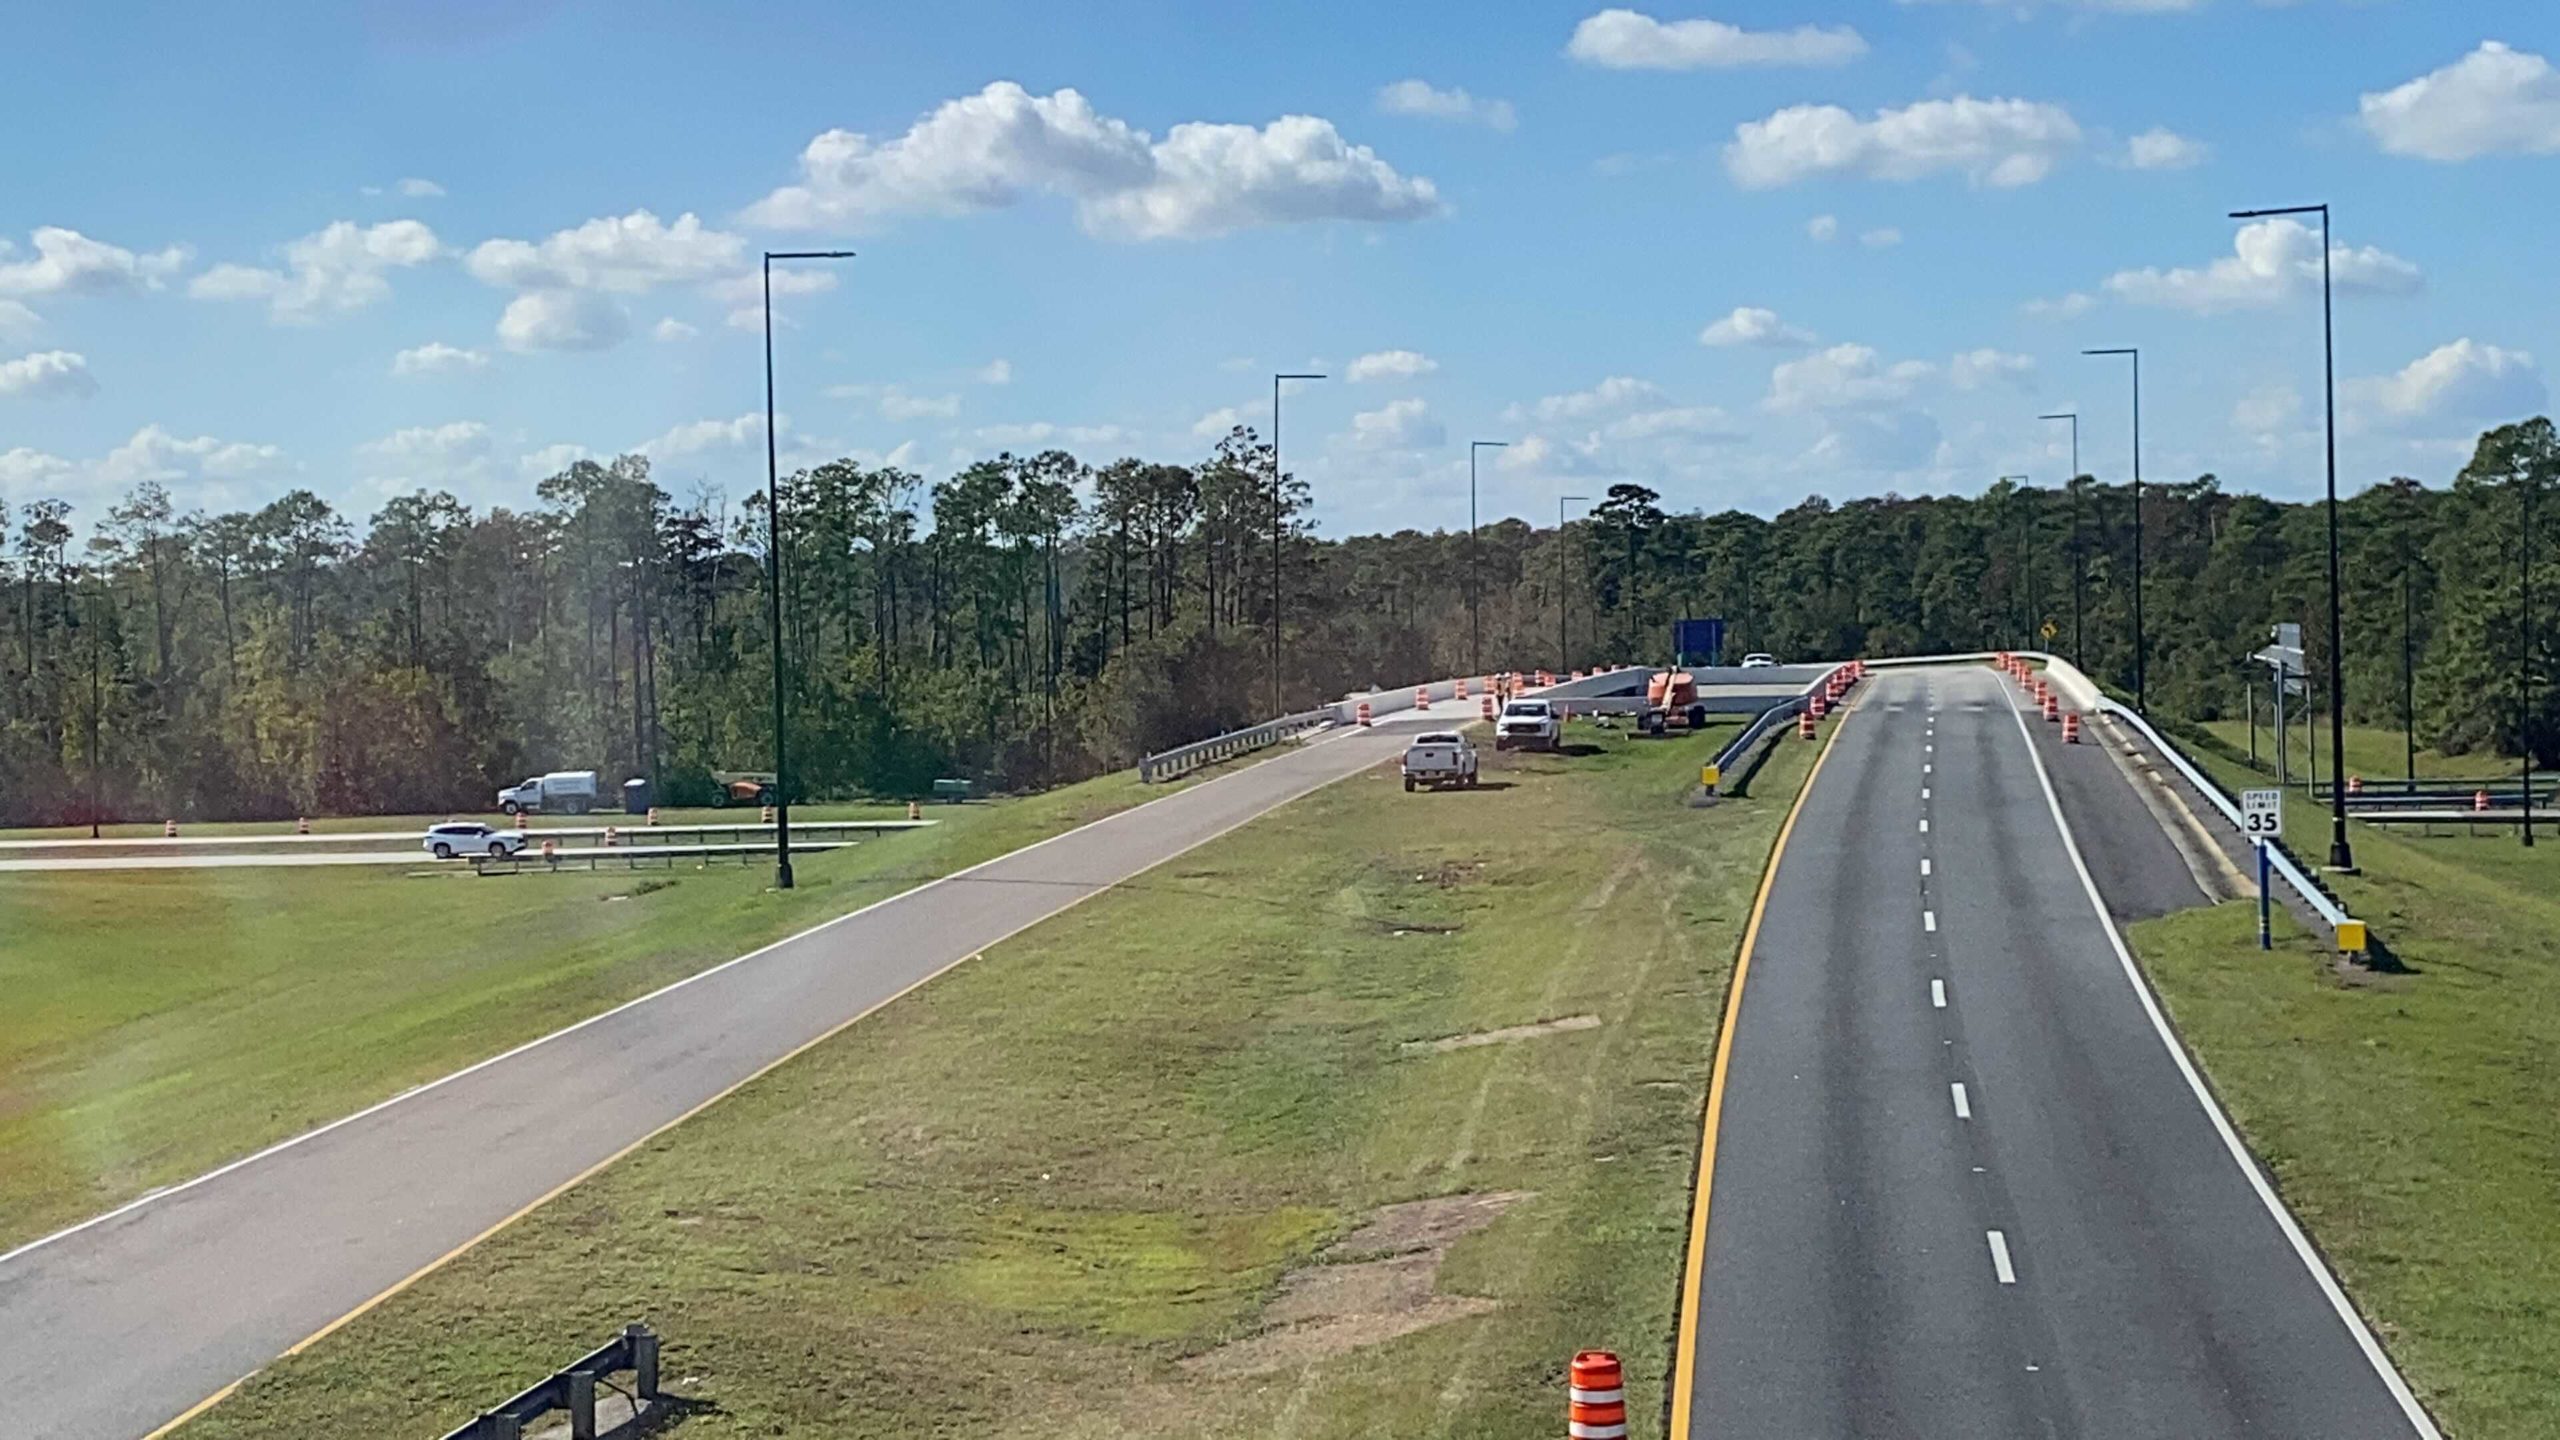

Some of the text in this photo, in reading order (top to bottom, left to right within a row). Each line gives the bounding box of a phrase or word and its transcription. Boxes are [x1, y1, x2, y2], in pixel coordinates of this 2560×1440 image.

[2246, 792, 2278, 800] SPEED
[2246, 801, 2277, 809] LIMIT
[2247, 813, 2277, 831] 35
